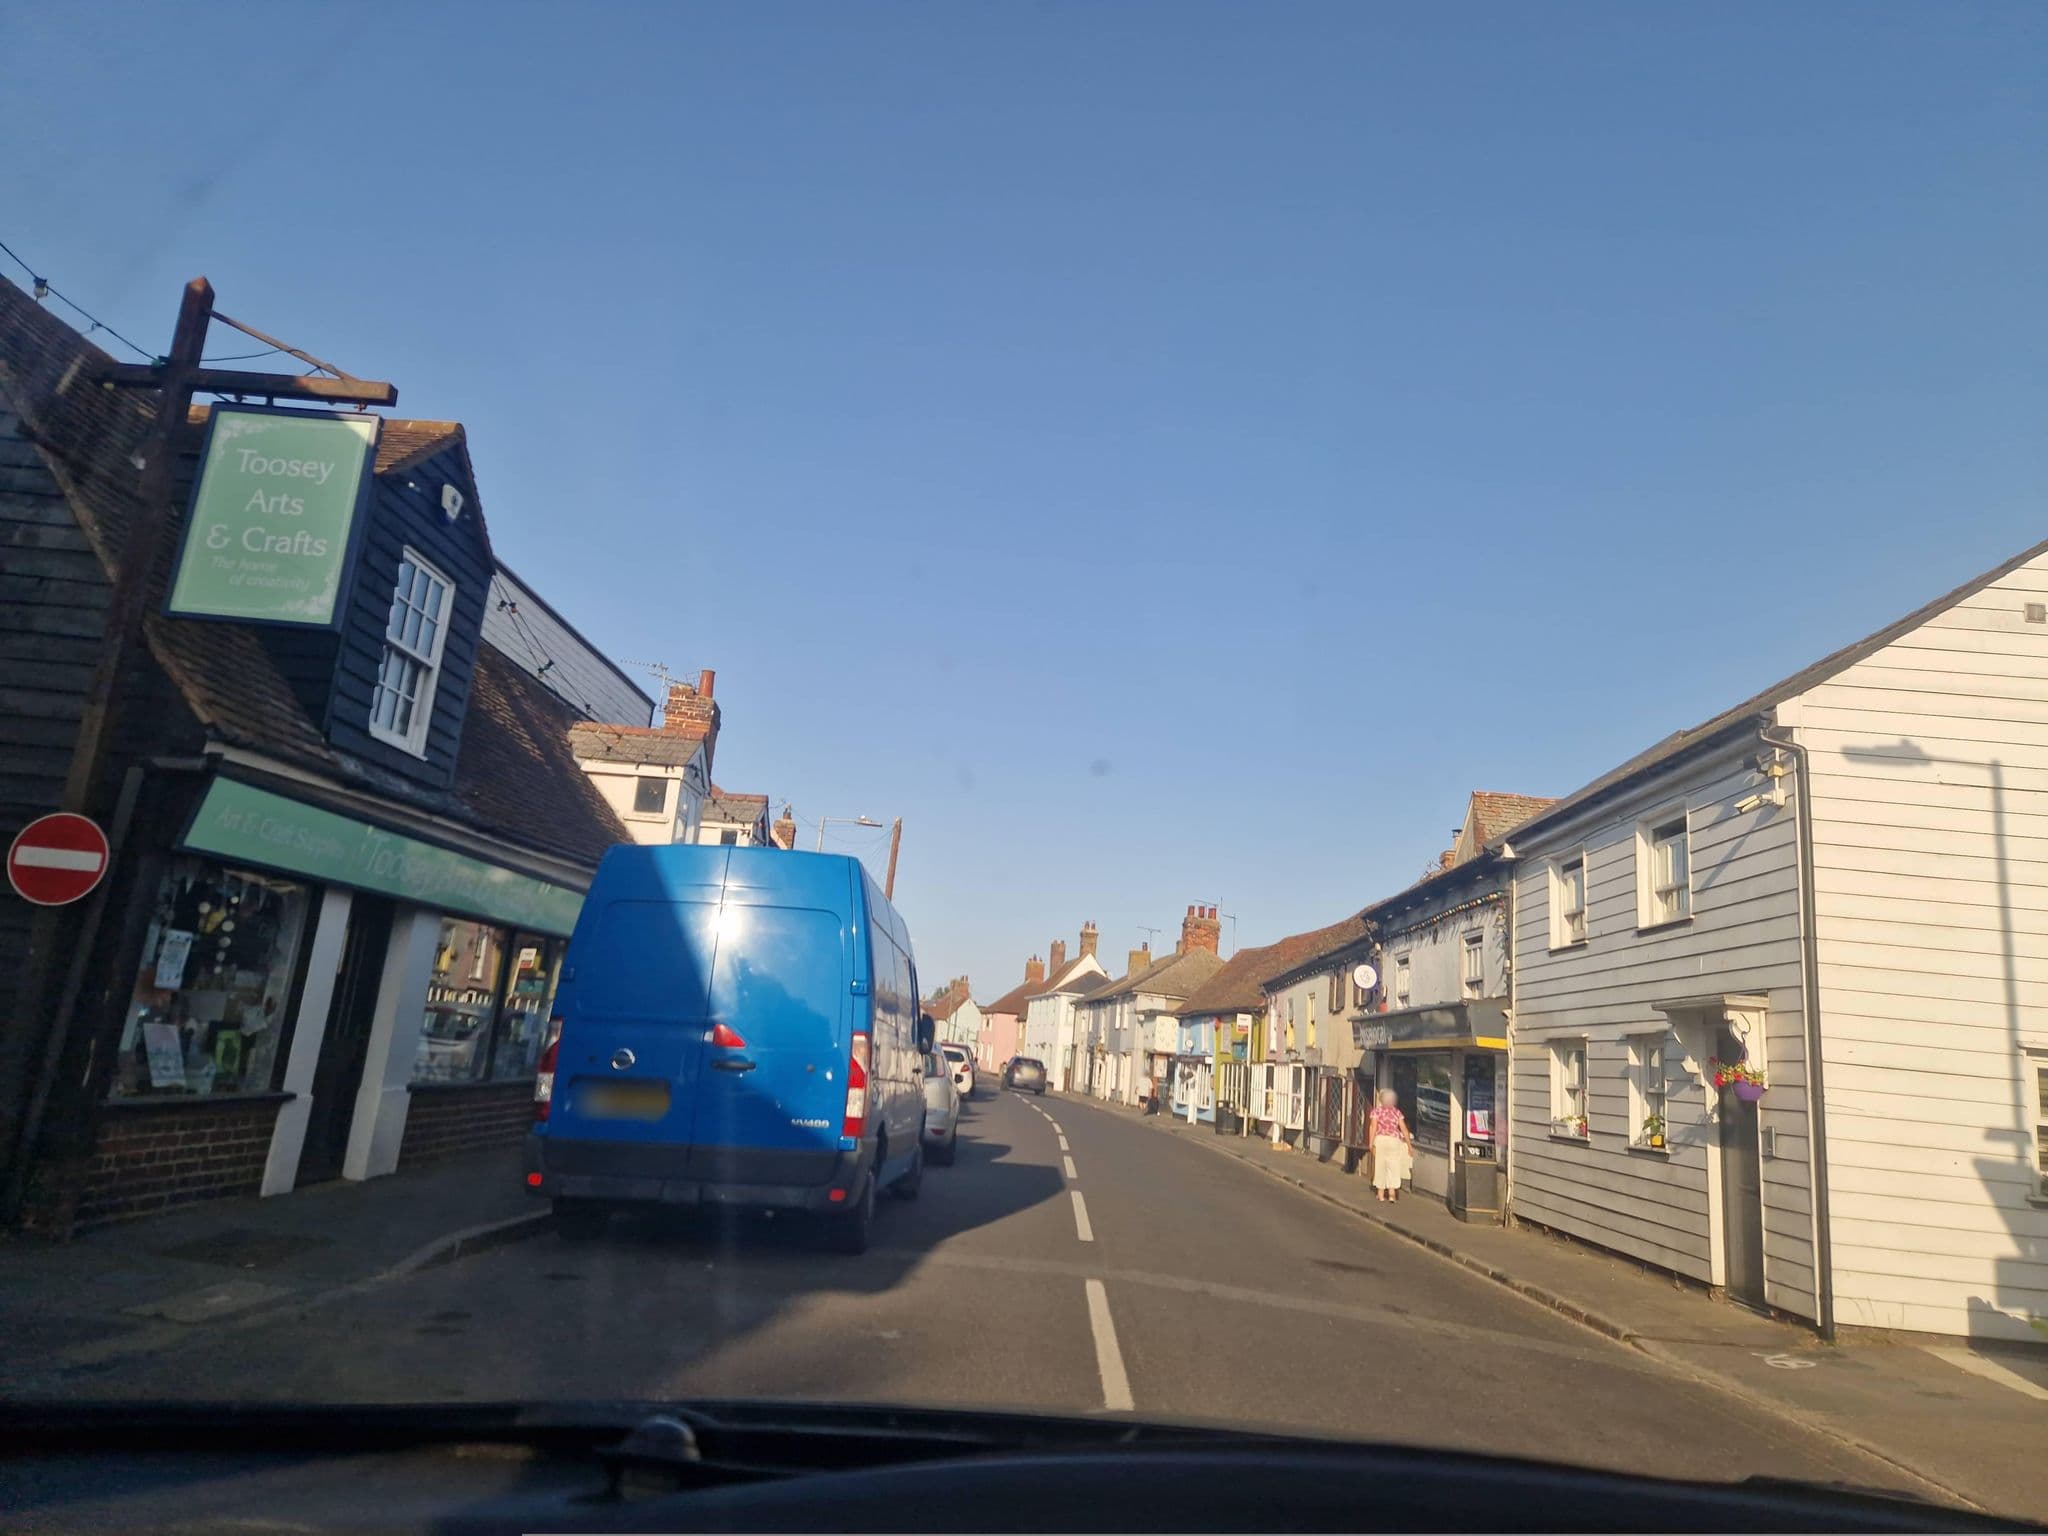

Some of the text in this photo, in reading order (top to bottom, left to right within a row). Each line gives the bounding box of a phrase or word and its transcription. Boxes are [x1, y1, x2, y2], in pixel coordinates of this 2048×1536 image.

[236, 448, 335, 485] Toosey
[245, 488, 304, 515] Arts
[206, 524, 328, 557] & Crafts
